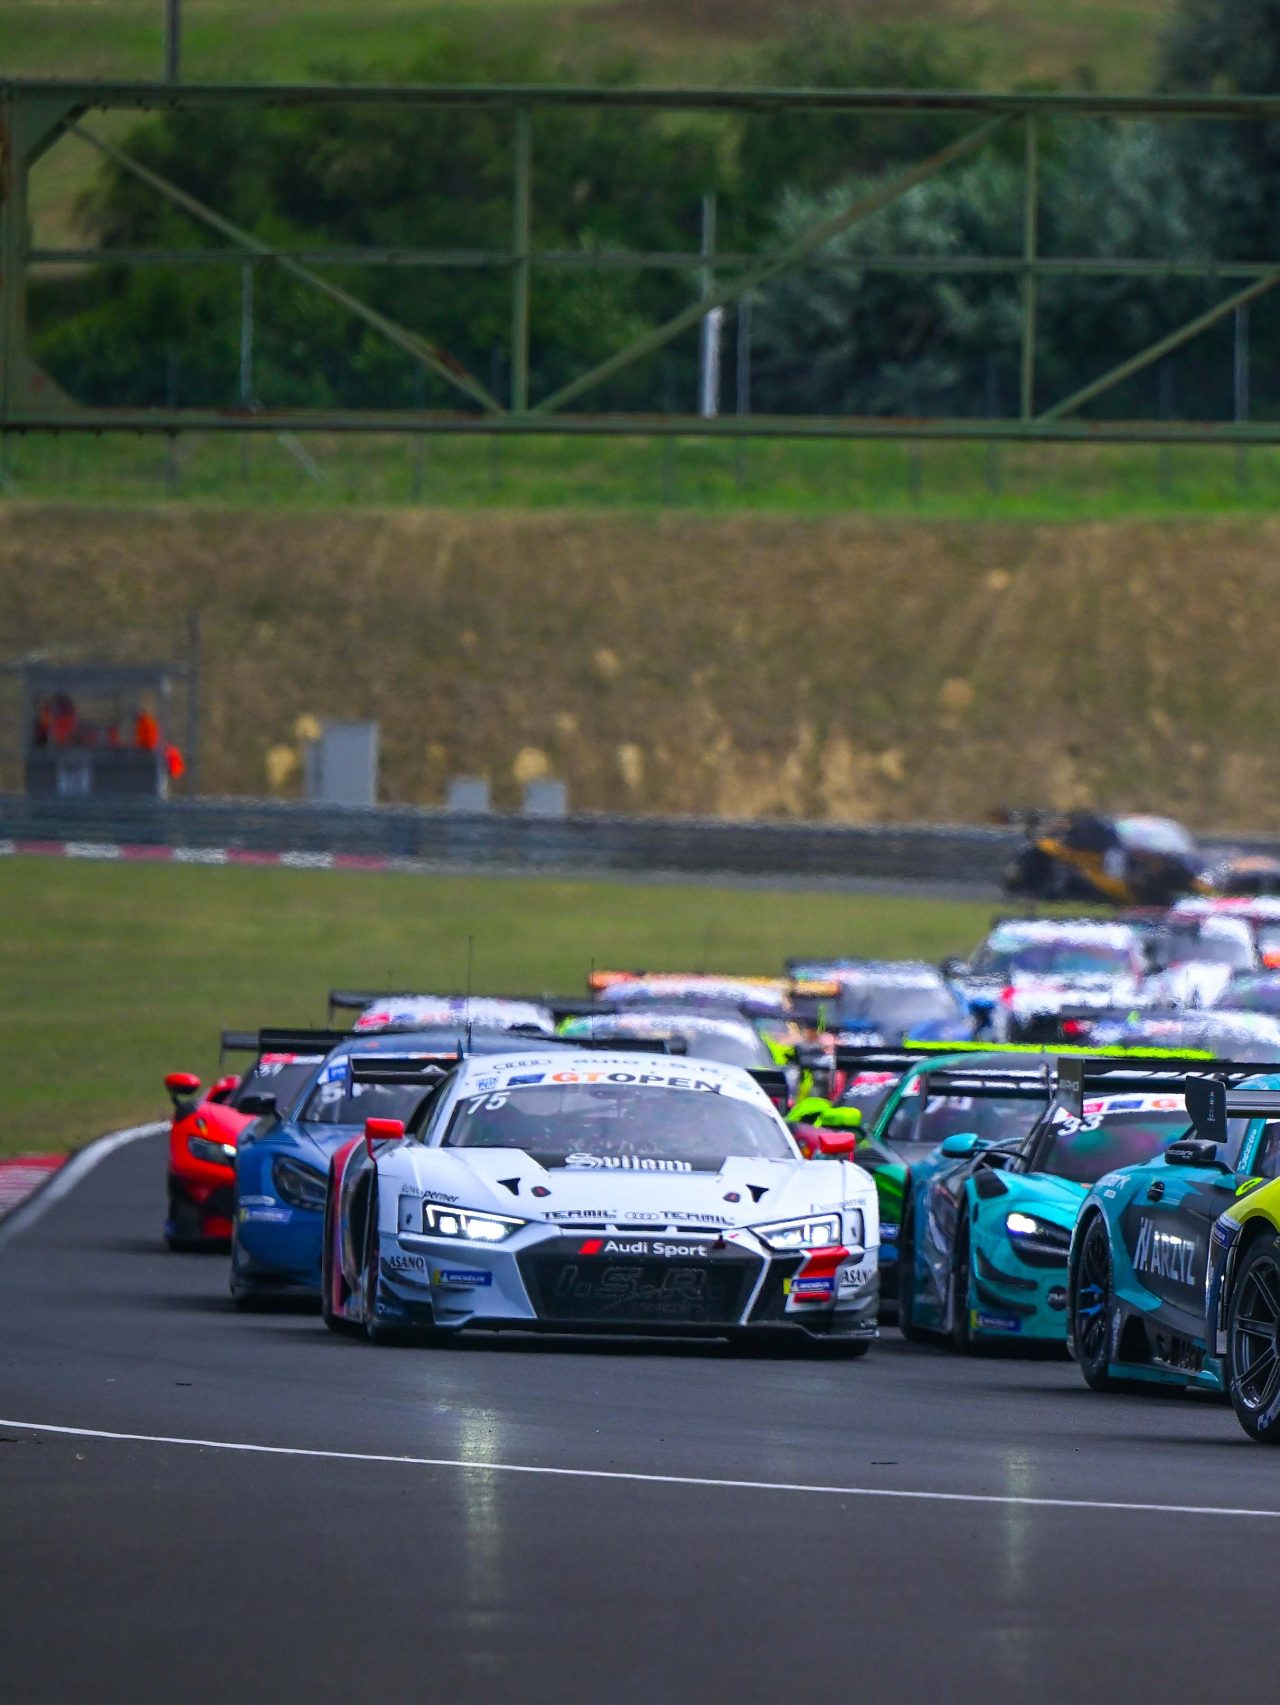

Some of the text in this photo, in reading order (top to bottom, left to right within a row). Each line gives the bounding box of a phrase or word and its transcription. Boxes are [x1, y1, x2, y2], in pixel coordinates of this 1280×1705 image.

[552, 1071, 722, 1095] GTOPEN
[467, 1091, 511, 1115] 75
[1057, 1114, 1104, 1136] 33
[604, 1240, 708, 1258] Audi Sport
